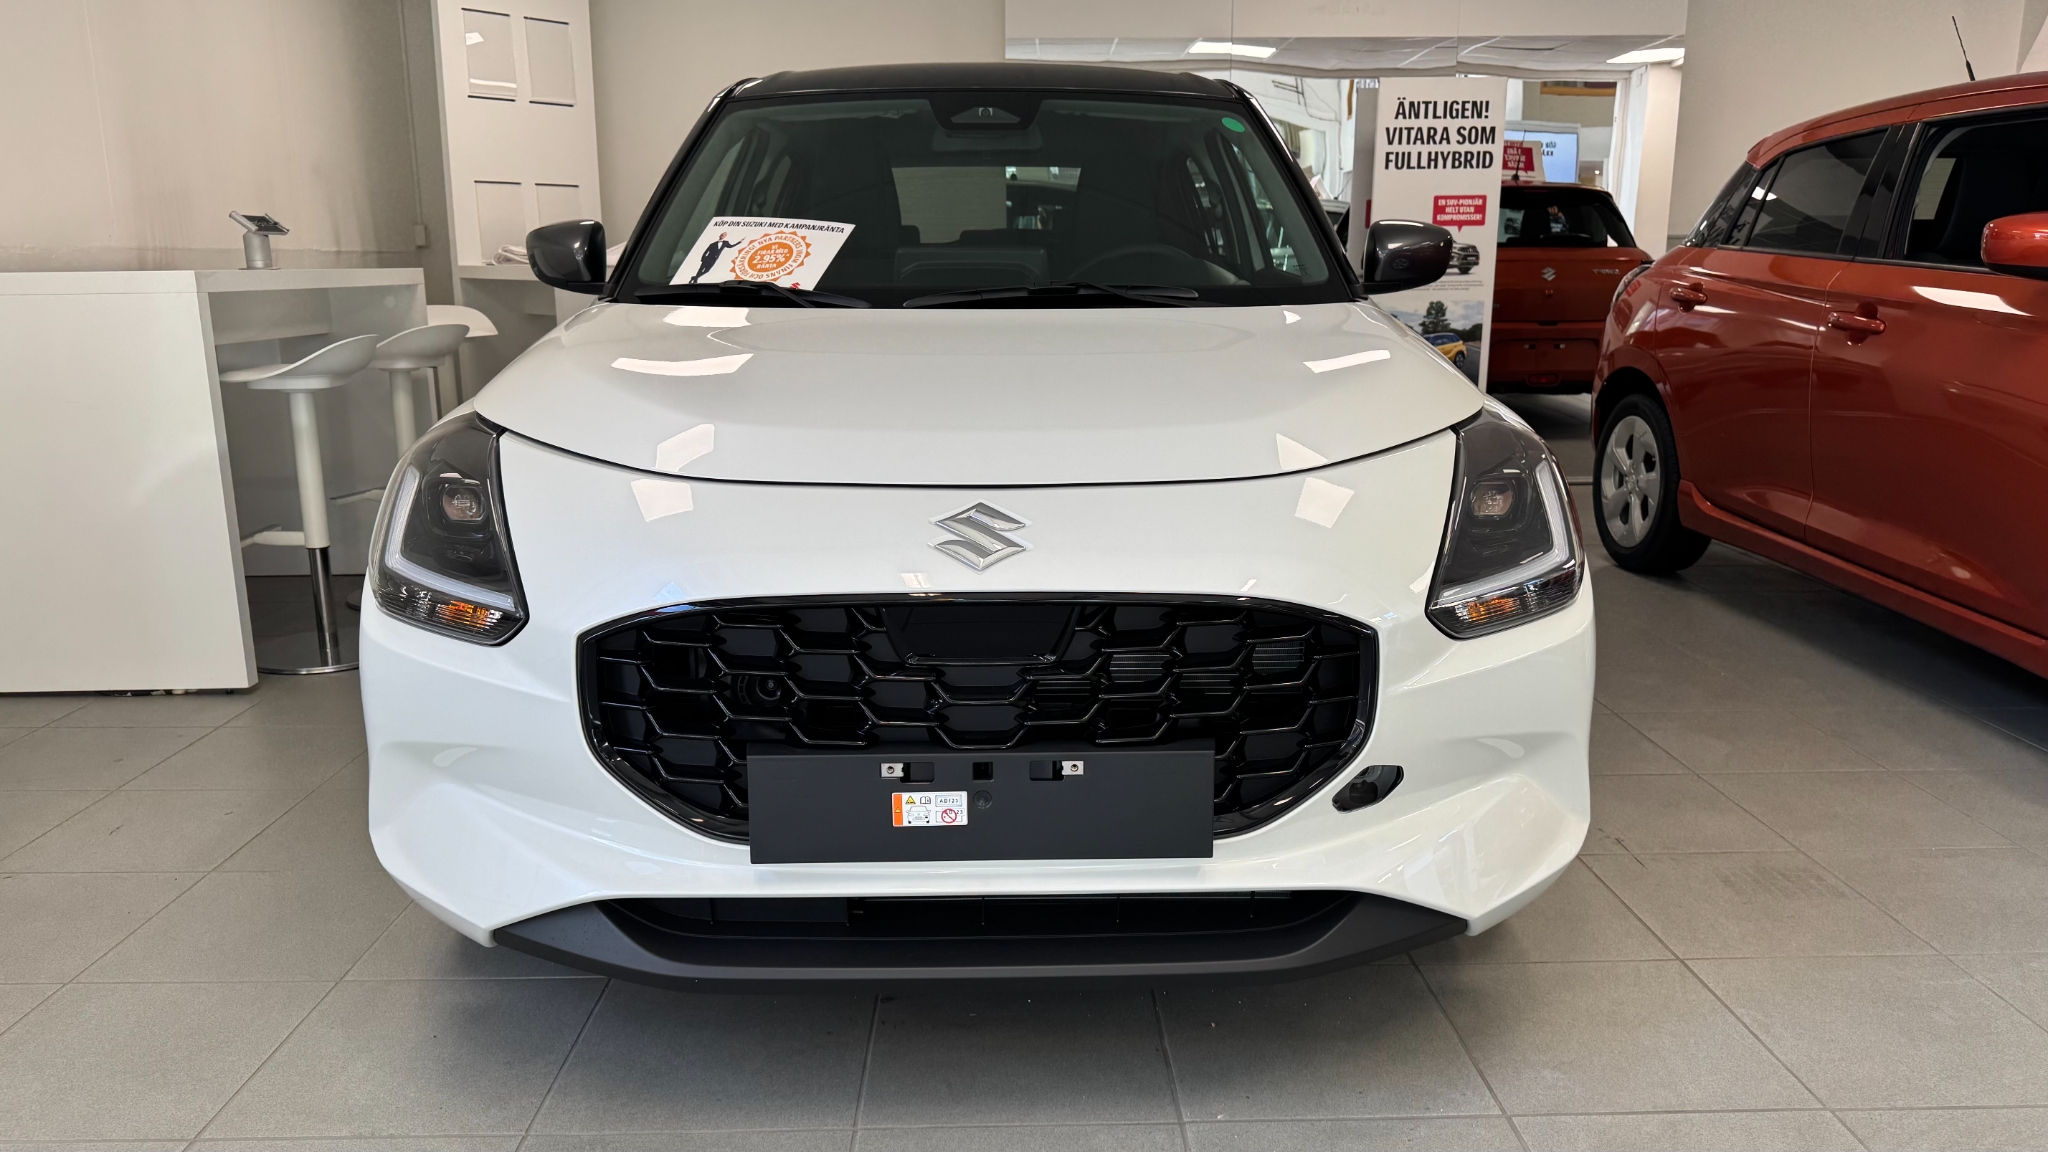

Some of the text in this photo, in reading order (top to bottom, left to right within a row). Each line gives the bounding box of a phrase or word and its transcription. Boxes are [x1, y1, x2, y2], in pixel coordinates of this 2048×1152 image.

[1394, 97, 1490, 120] ÄNTLIGEN!
[1385, 126, 1496, 146] VITARA SOM
[1385, 151, 1494, 170] FULLHYBRID
[1446, 198, 1483, 206] SUV-PIONJÄR
[757, 237, 773, 246] NYA
